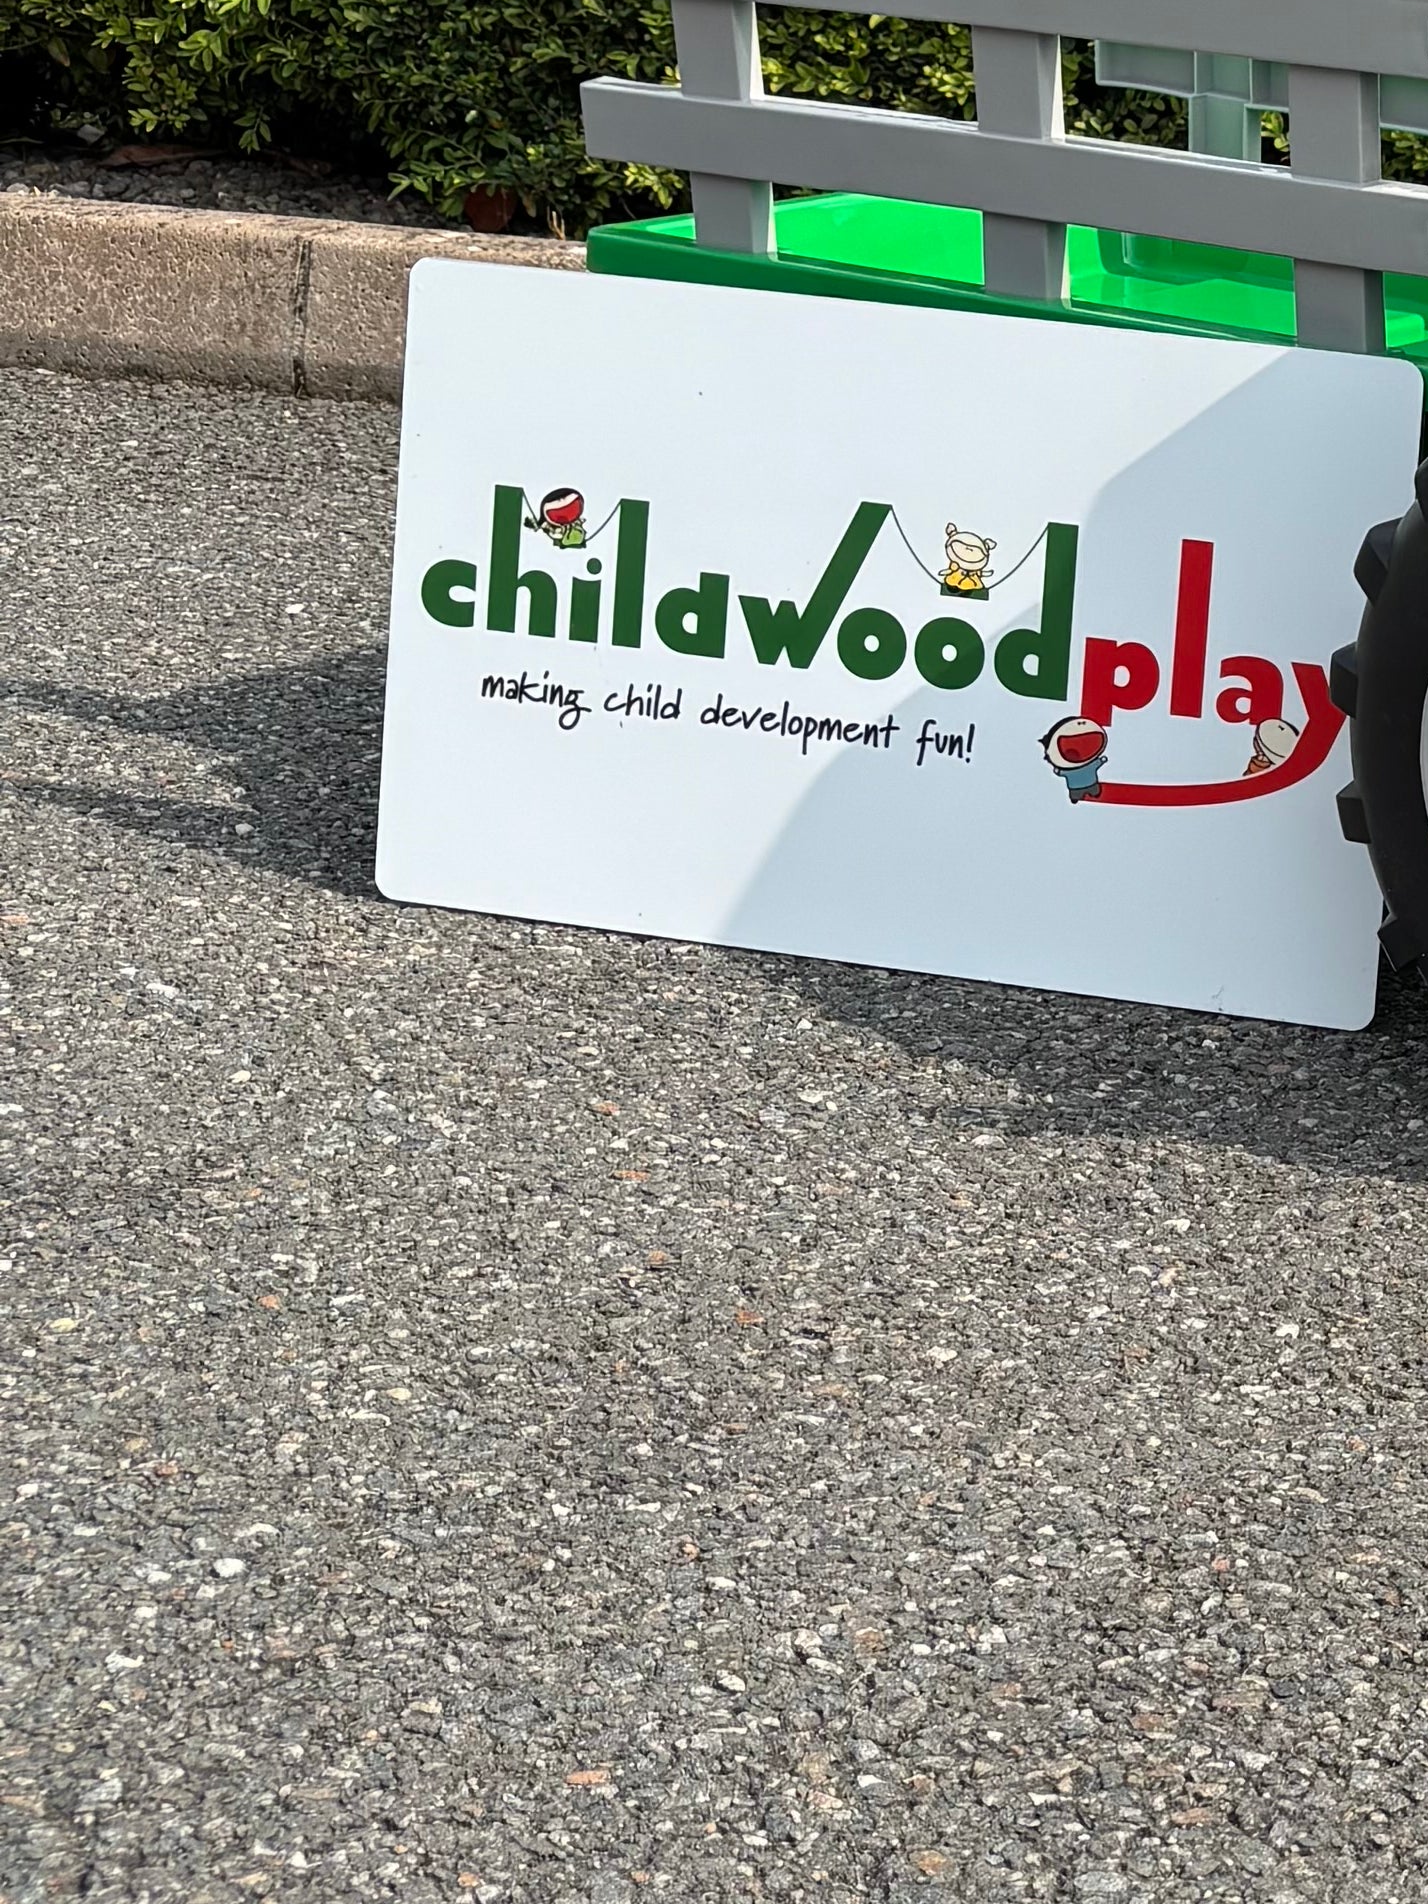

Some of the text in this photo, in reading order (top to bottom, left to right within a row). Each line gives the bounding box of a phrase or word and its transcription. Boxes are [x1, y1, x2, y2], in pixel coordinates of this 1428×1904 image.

[481, 671, 976, 766] making child development fun!
